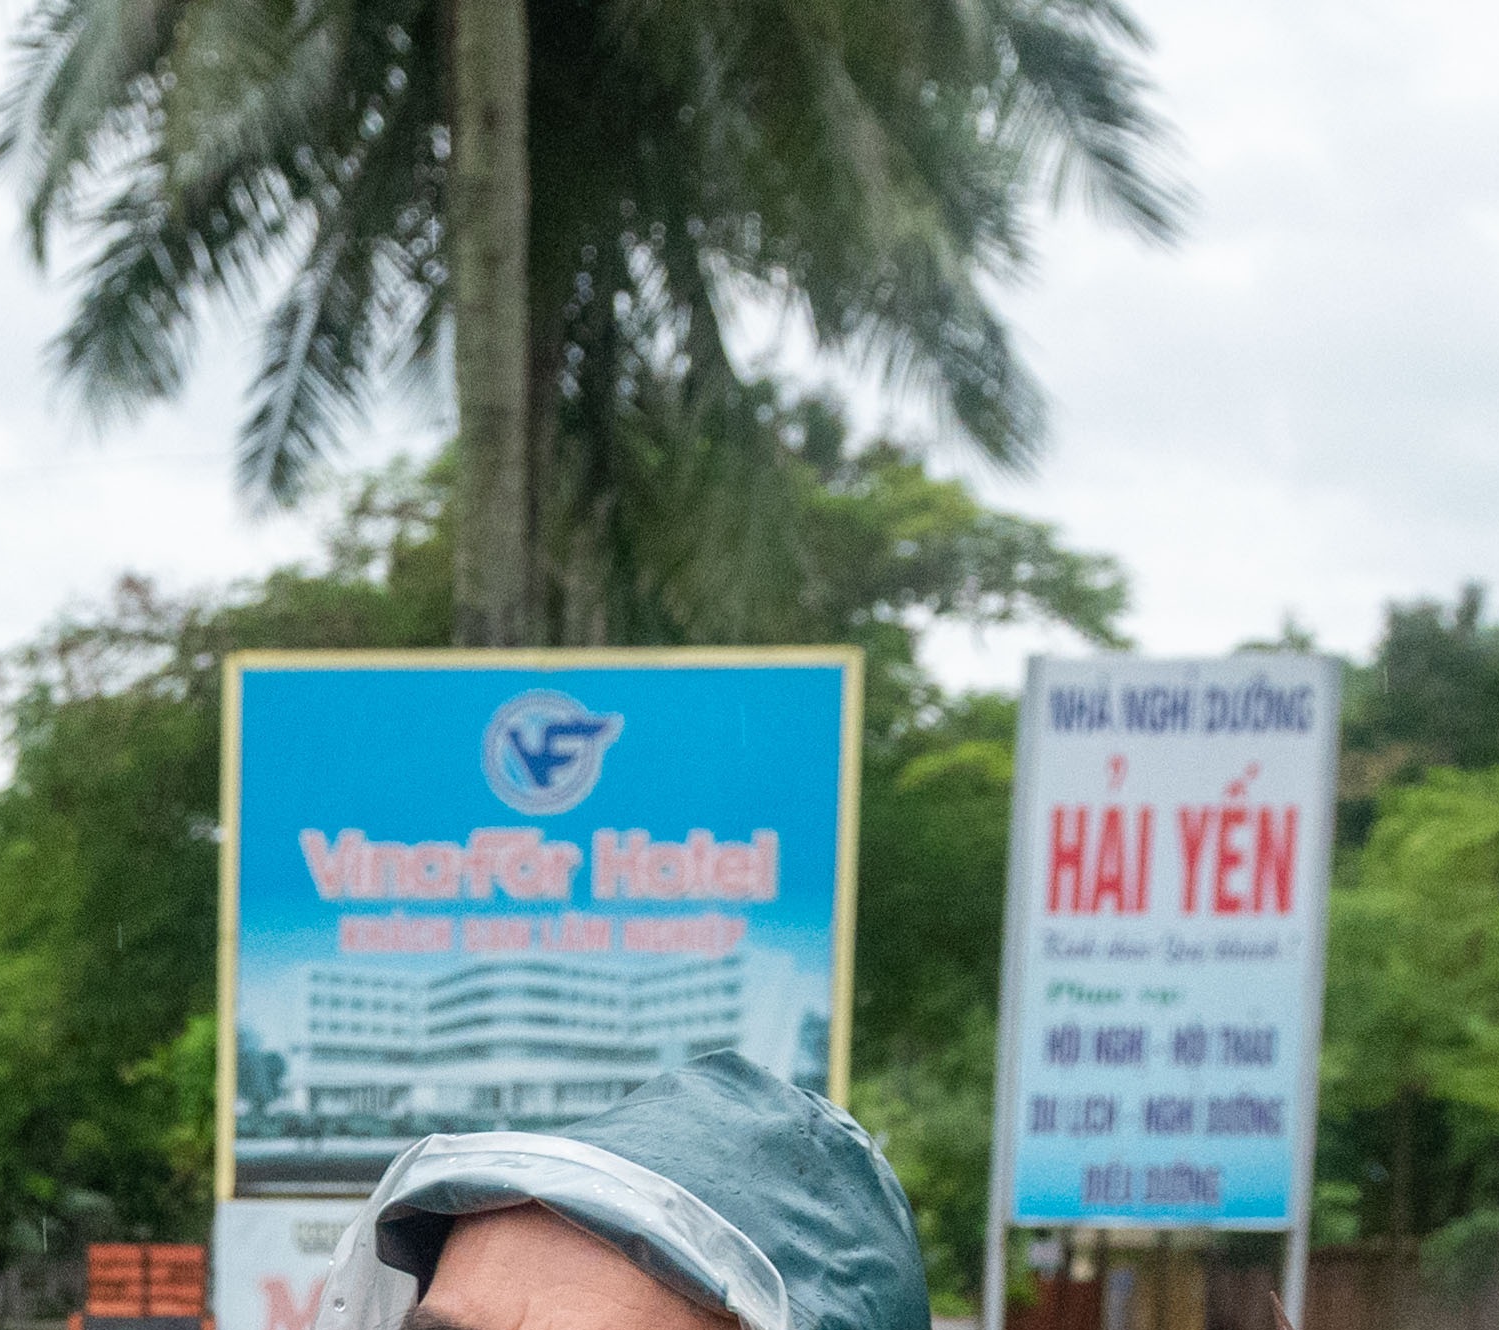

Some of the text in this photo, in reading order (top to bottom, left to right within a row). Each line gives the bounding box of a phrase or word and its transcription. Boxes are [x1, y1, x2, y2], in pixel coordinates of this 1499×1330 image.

[591, 827, 780, 901] Hotel
[1047, 752, 1299, 914] HẢI YẾN
